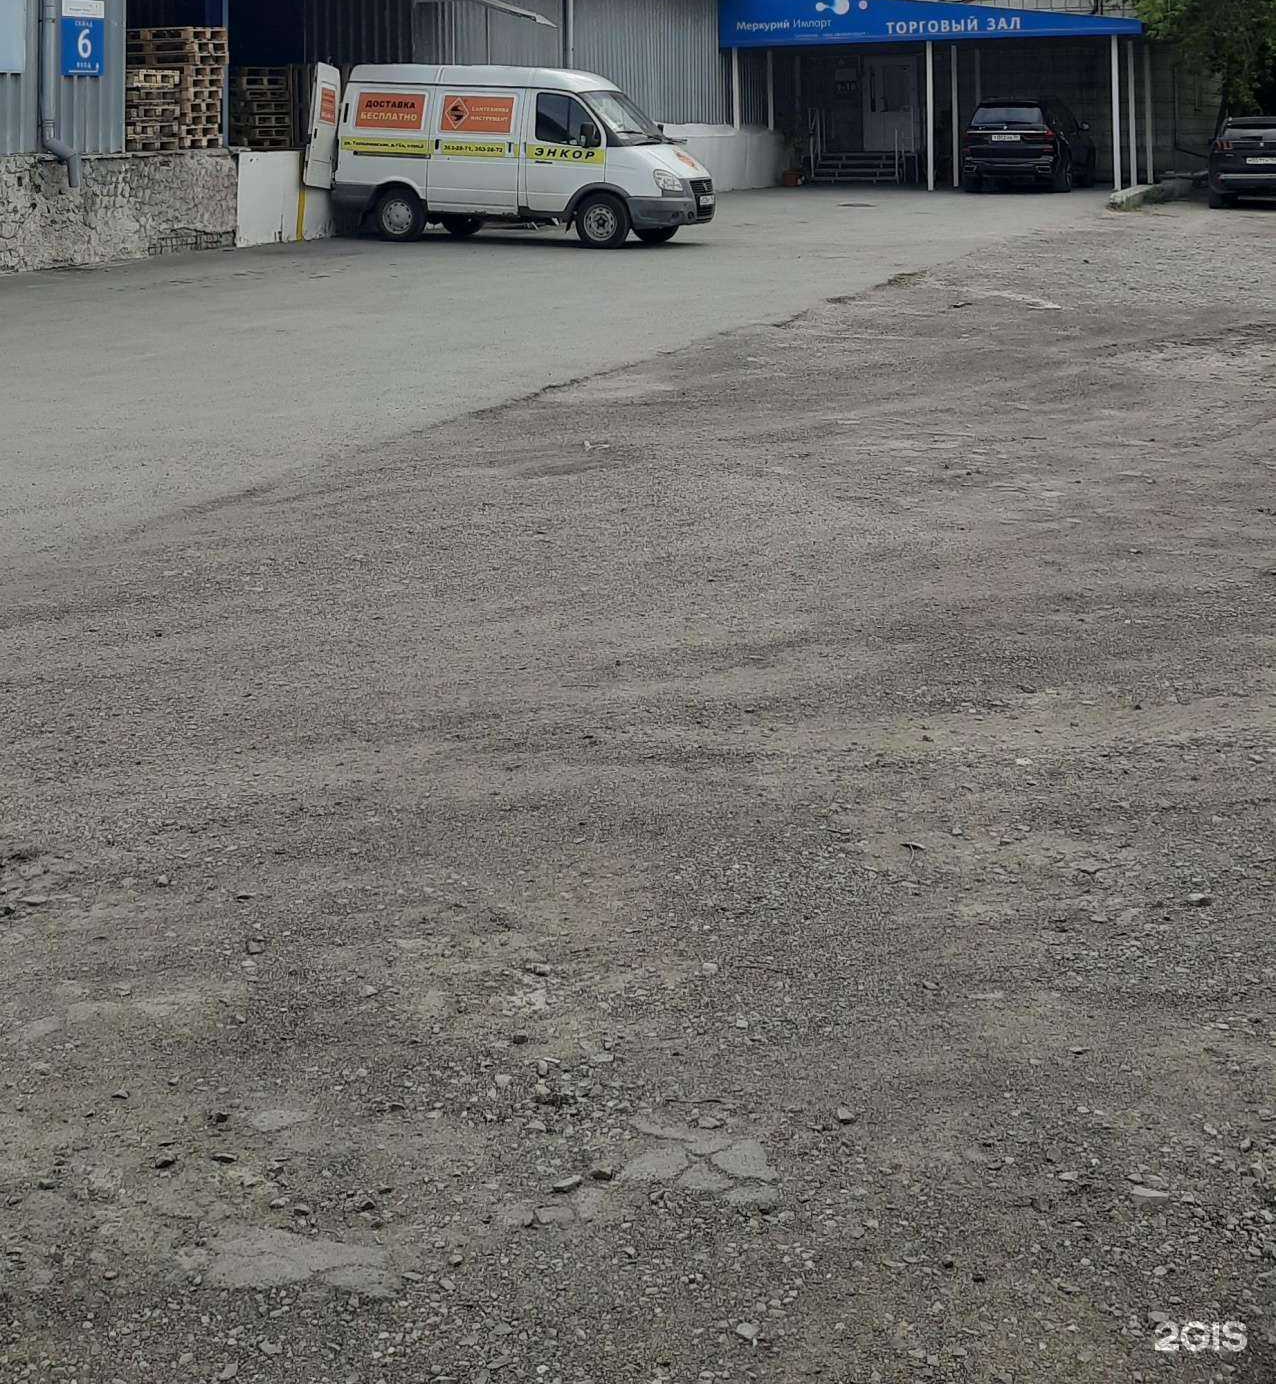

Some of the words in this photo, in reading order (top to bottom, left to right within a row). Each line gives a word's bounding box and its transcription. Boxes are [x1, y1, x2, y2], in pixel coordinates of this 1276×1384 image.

[736, 20, 790, 32] Меркурий
[793, 19, 831, 30] Импорт
[886, 16, 978, 34] ТОРГОВЫЙ
[986, 17, 1021, 30] ЗАЛ
[78, 29, 92, 58] 6
[365, 100, 416, 109] ДОСТАВКА
[360, 112, 417, 121] БЕСПЛАТНО
[534, 148, 596, 159] ЭНКОР
